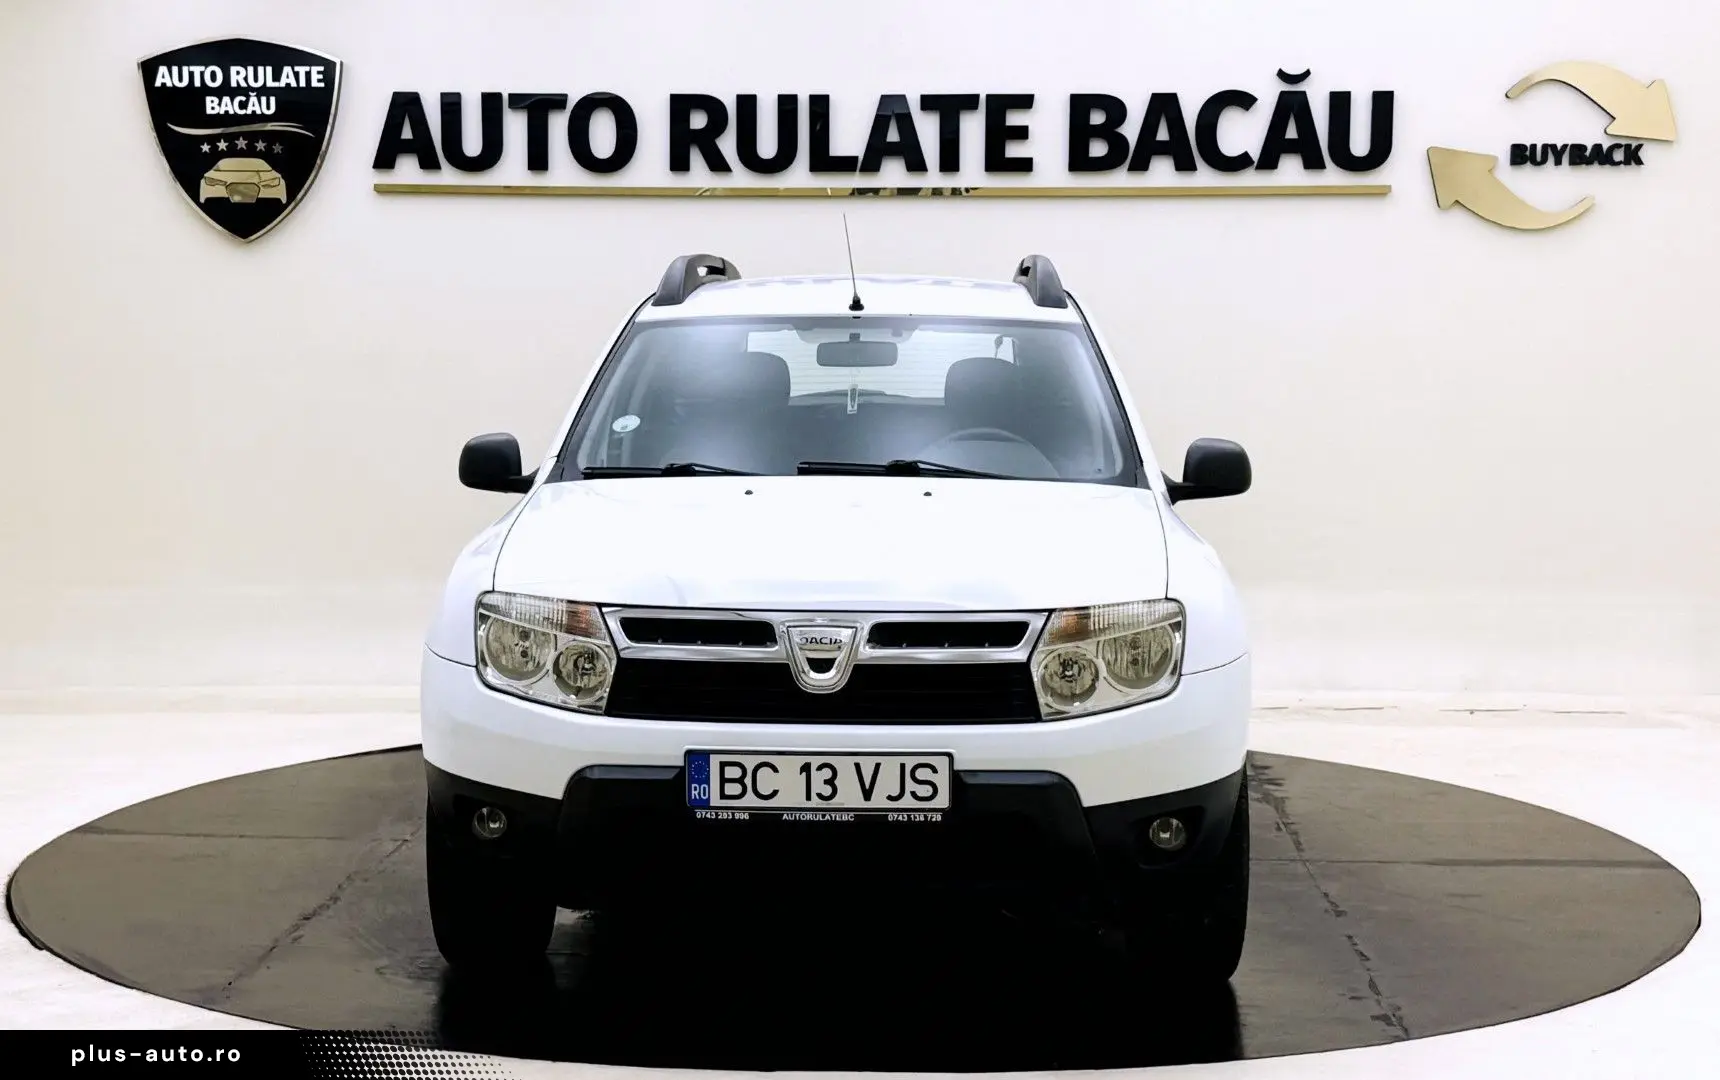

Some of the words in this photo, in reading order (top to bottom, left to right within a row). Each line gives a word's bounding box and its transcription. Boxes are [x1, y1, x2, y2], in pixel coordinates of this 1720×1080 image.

[154, 65, 224, 88] AUTO
[230, 65, 325, 88] RULATE
[205, 91, 277, 115] BACĂU
[372, 91, 638, 173] AUTO
[669, 93, 1035, 174] RULATE
[1068, 67, 1395, 173] BACĂU
[1509, 143, 1645, 167] BUYBACK
[691, 783, 709, 800] RO
[718, 760, 780, 801] BC
[799, 761, 839, 802] 13
[853, 761, 939, 802] VJS
[696, 811, 716, 819] 0743
[887, 814, 908, 822] 0743
